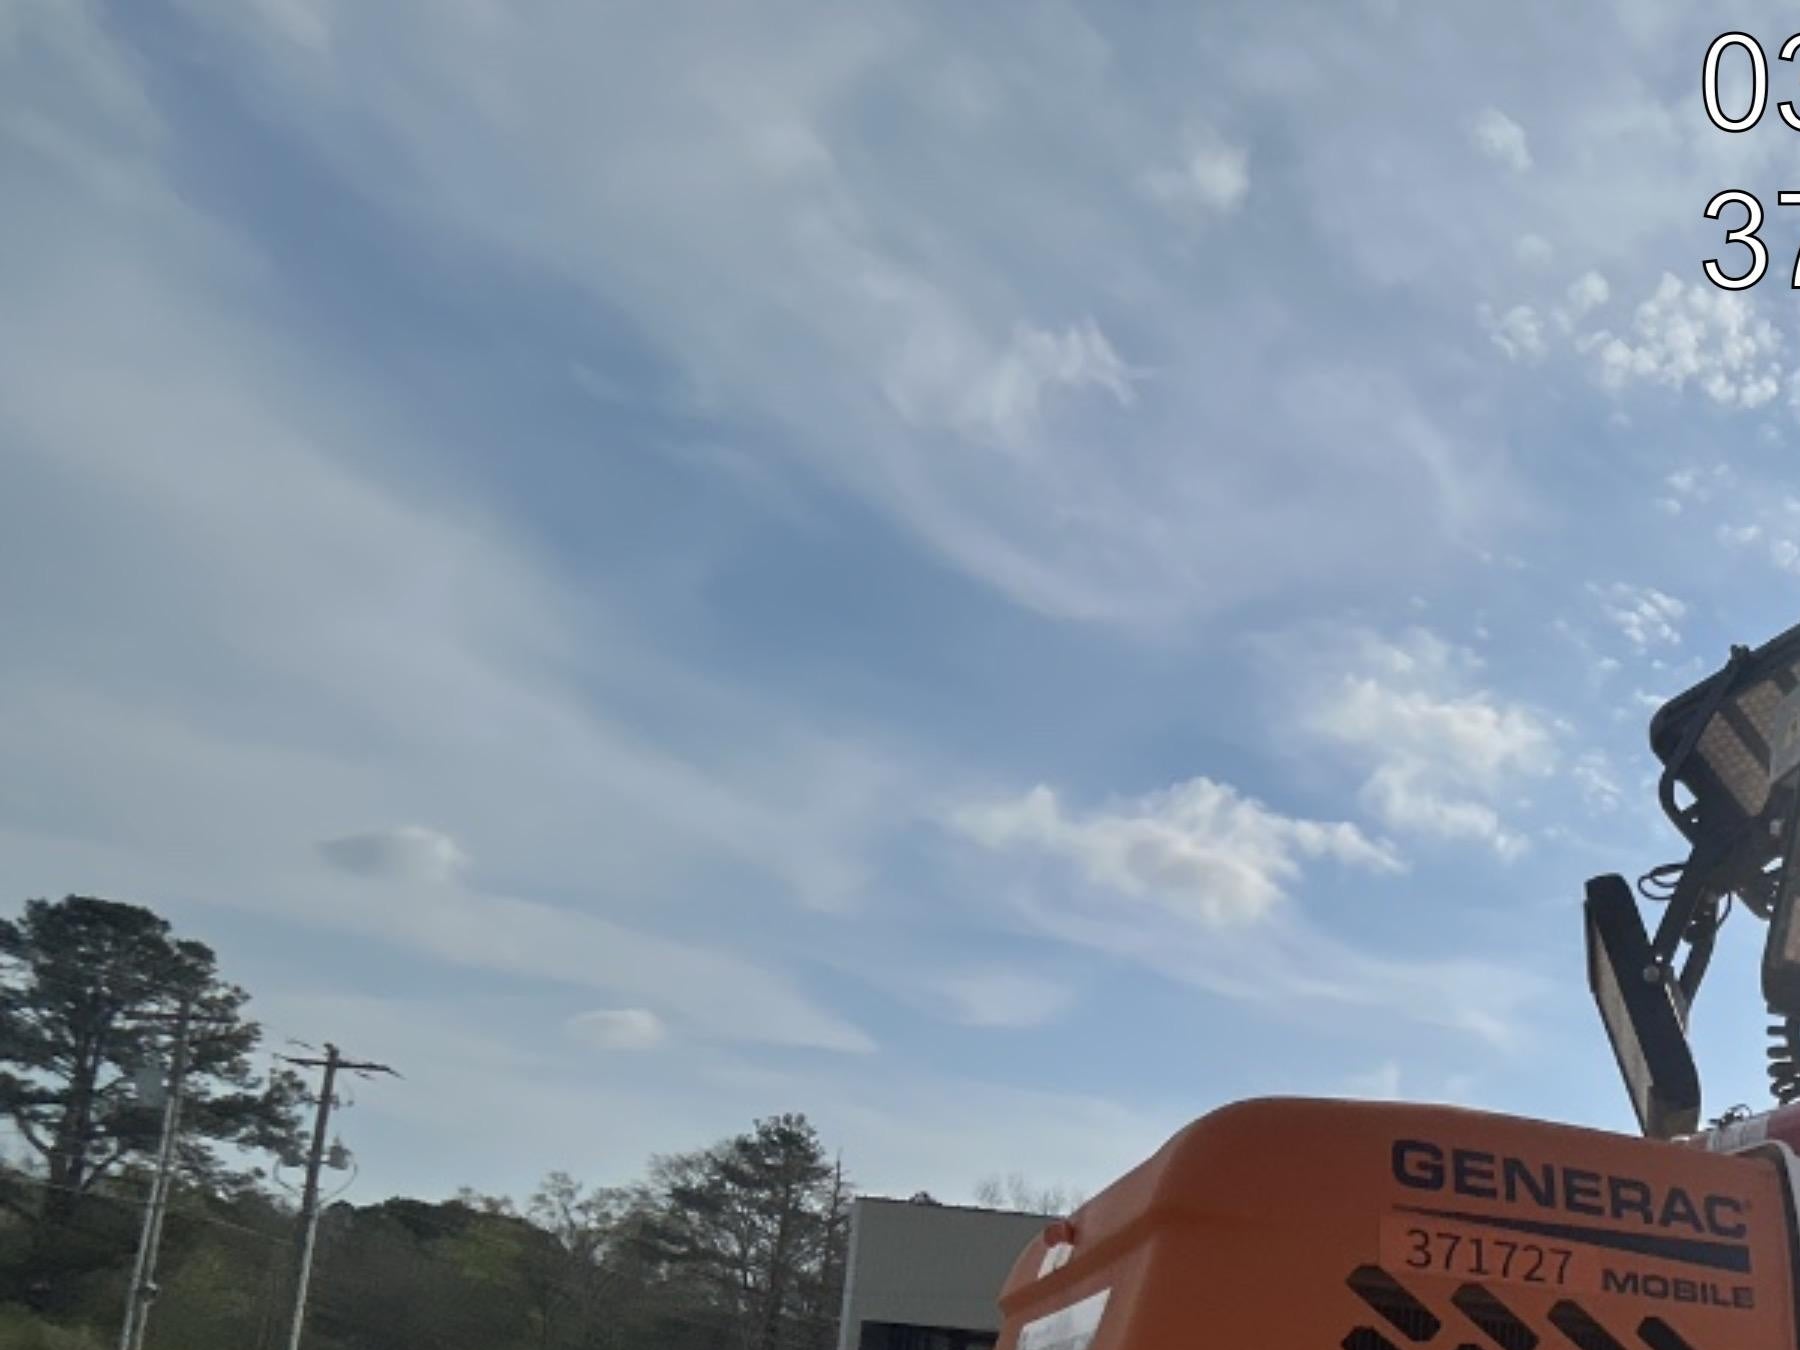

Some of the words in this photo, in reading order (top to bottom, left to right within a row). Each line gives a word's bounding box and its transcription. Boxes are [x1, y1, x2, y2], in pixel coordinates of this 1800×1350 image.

[1391, 1139, 1748, 1239] GENERAC
[1406, 1229, 1573, 1285] 371727
[1602, 1267, 1755, 1309] MOBILE
